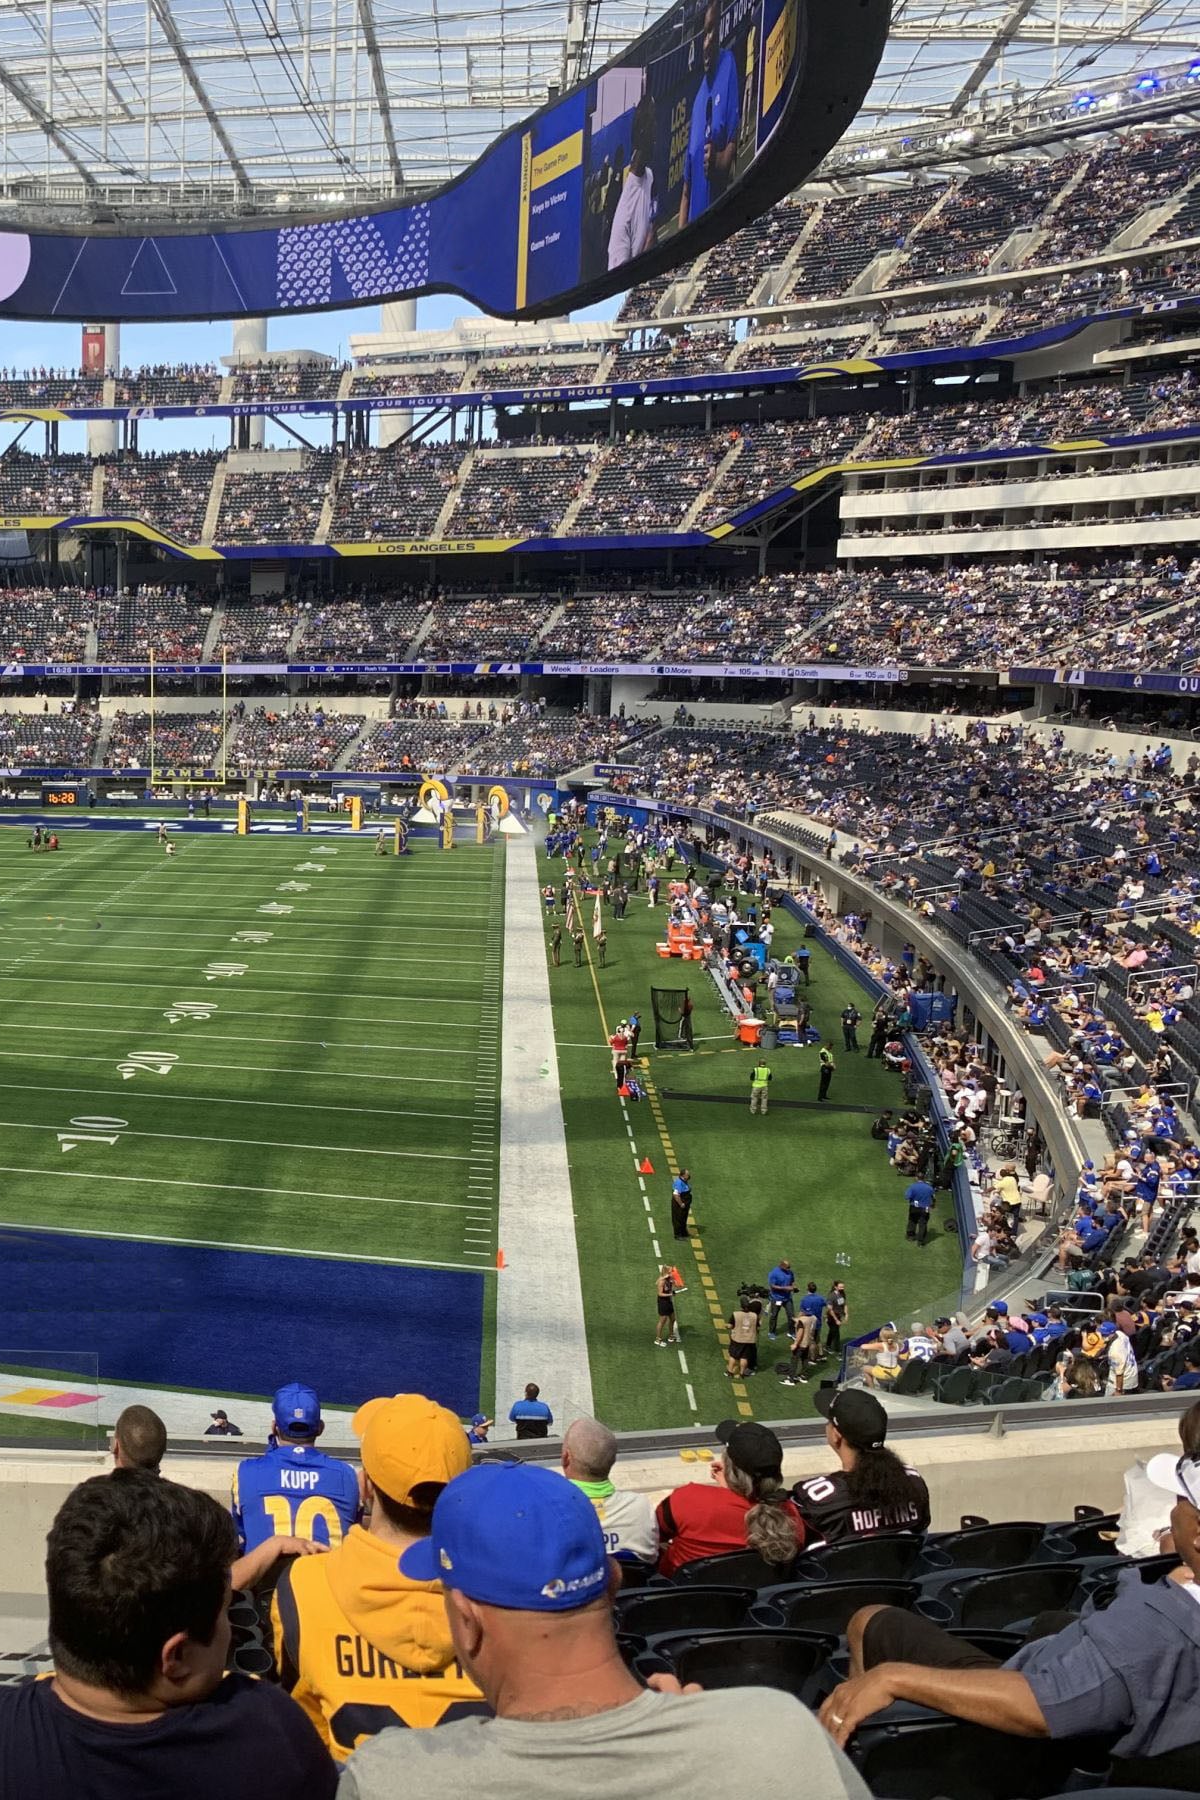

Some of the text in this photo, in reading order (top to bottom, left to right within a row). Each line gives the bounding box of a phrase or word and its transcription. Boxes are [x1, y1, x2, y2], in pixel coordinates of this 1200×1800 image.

[233, 387, 613, 414] OUR HOUSE YOUR HOUSE RAMS HOUSE
[377, 543, 476, 553] LOS ANGELES
[551, 665, 620, 674] Week Leaders
[795, 669, 819, 677] D.Smith
[864, 671, 876, 679] 105
[1179, 677, 1200, 692] OU
[215, 770, 277, 778] HOUSE
[49, 793, 75, 804] 16:28
[202, 962, 249, 977] 40
[163, 1001, 219, 1021] 30
[116, 1051, 180, 1076] 20
[57, 1115, 130, 1146] 10
[280, 1468, 319, 1490] KUPP
[802, 1476, 835, 1502] 10
[263, 1495, 342, 1549] 10
